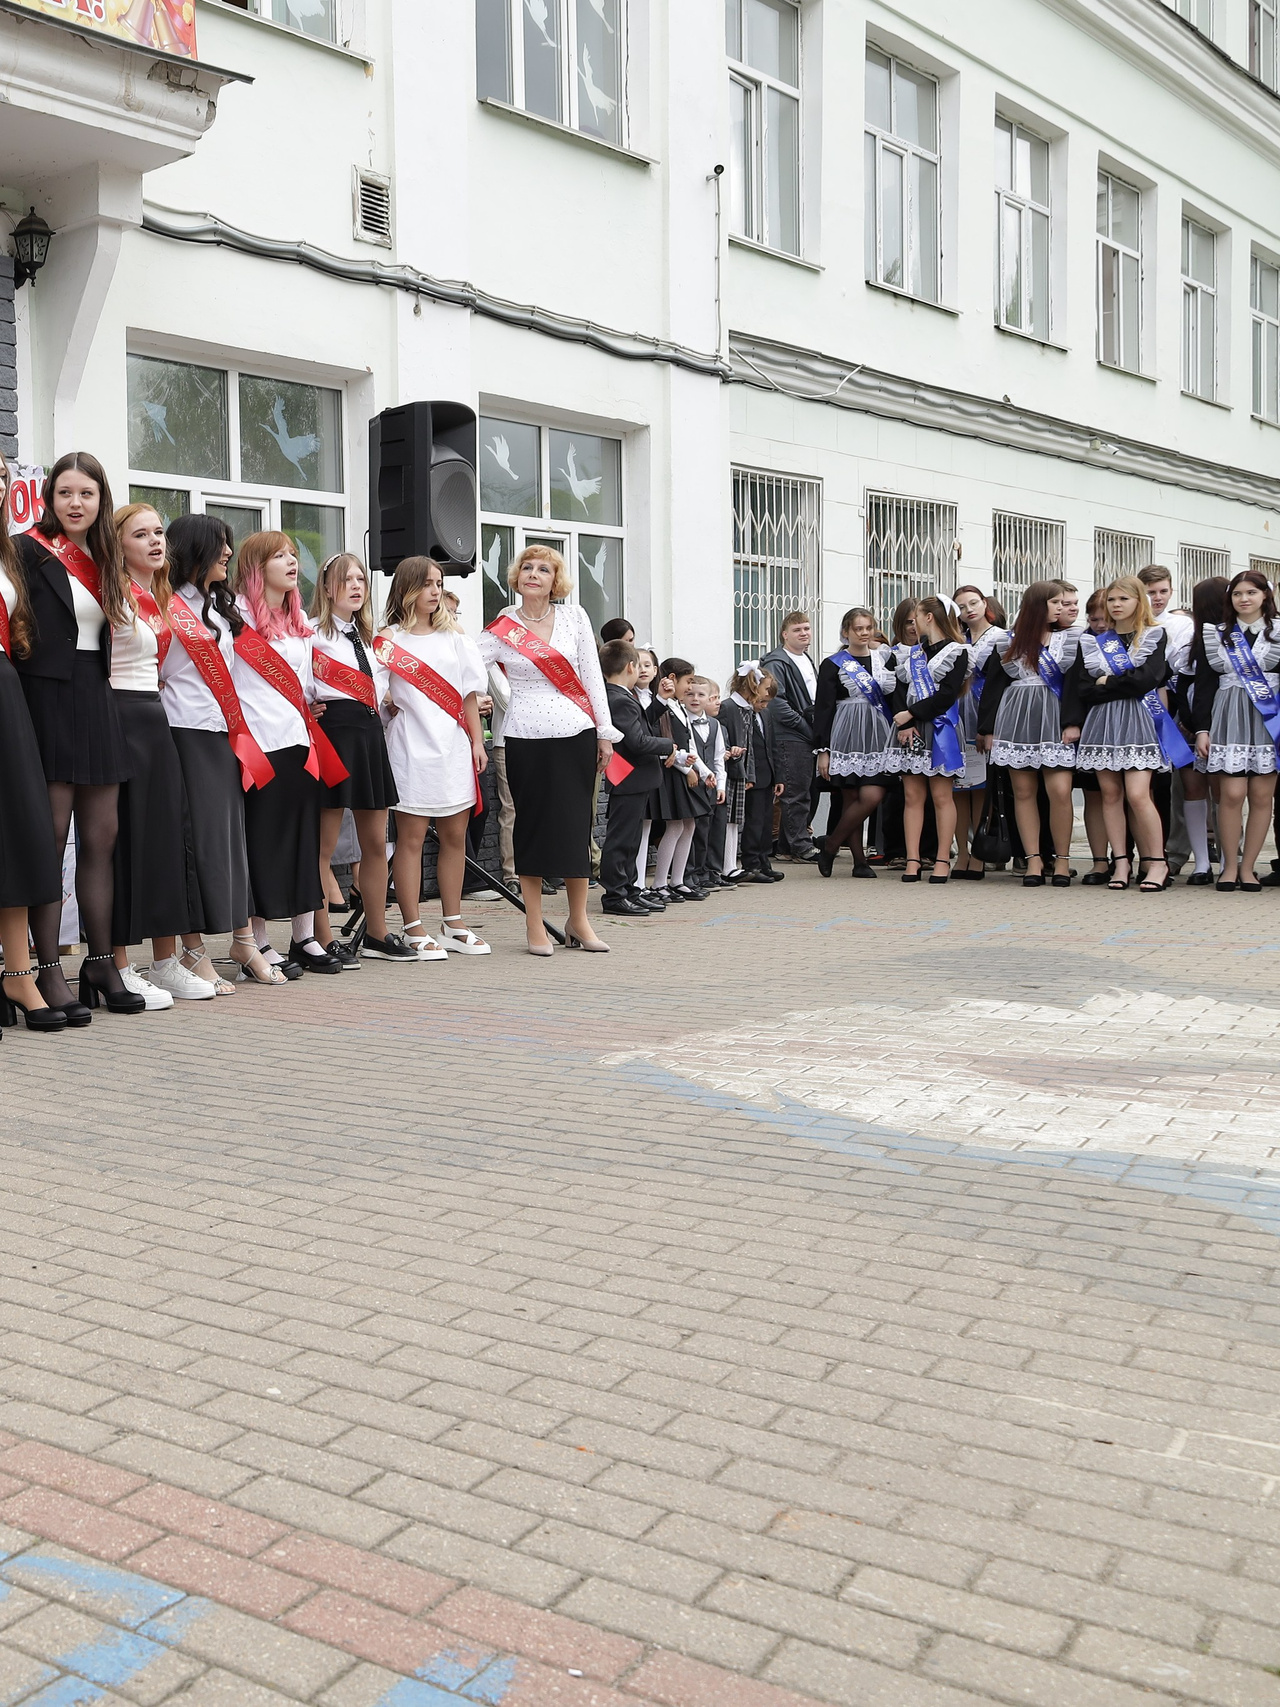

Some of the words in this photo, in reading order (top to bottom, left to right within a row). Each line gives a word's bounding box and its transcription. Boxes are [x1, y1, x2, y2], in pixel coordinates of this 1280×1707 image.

[172, 608, 225, 689] Выпускница
[220, 687, 243, 729] 2025
[396, 655, 459, 711] Выпускница
[525, 639, 568, 680] Классный
[1249, 679, 1272, 701] 2025
